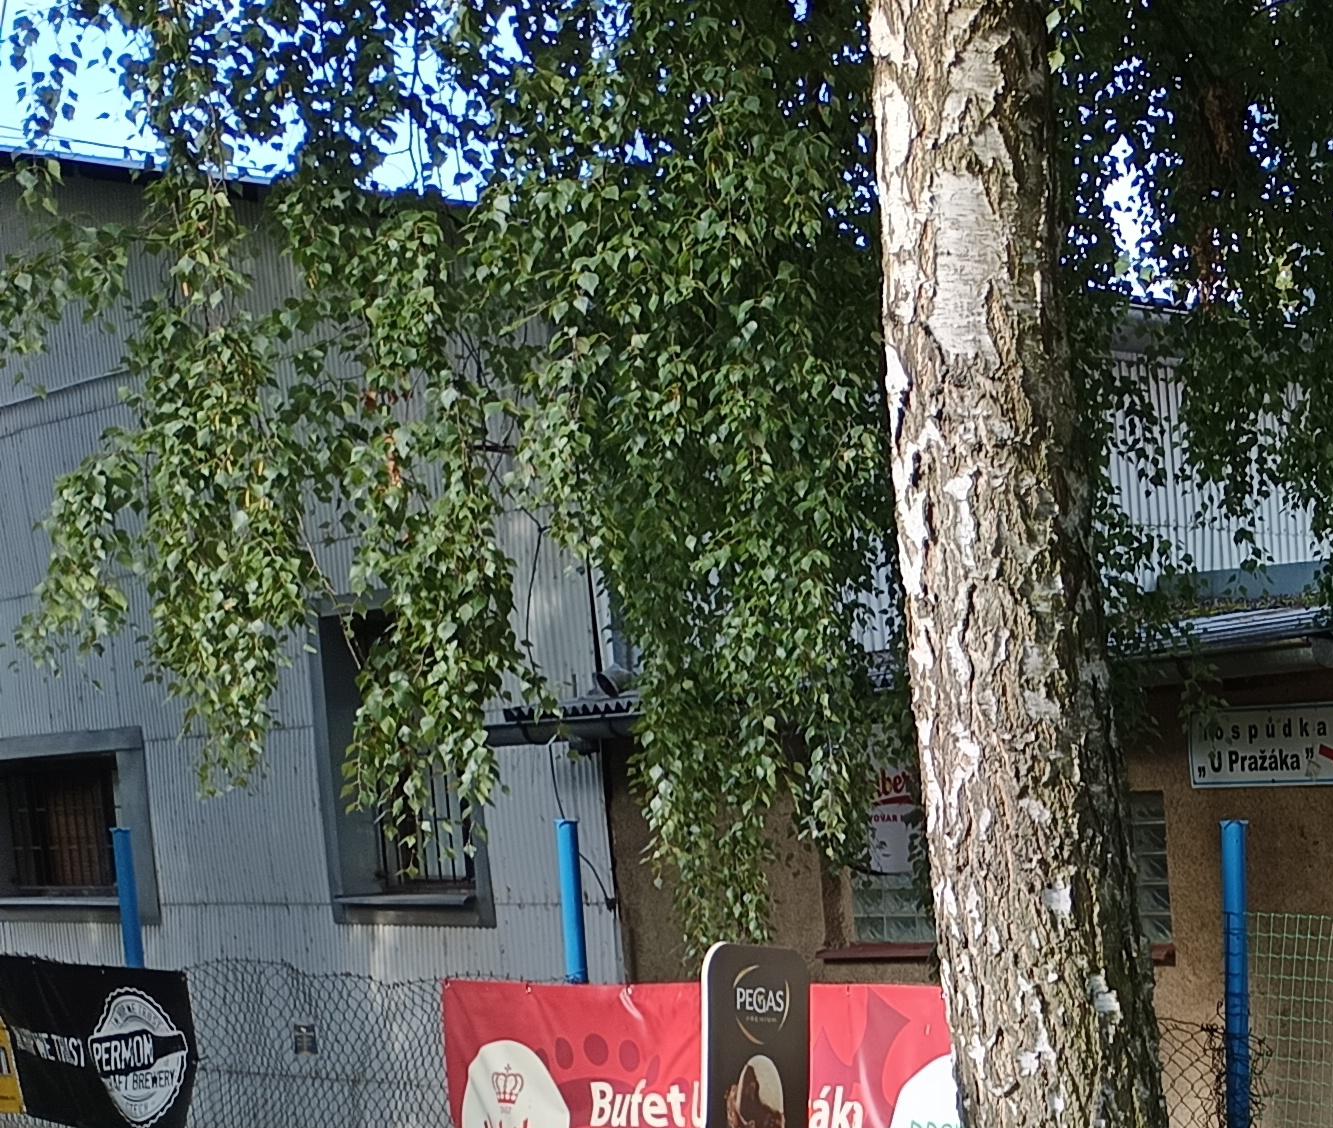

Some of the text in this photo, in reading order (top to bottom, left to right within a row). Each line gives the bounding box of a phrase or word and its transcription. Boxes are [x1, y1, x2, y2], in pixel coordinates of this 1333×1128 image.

[736, 986, 785, 1014] PEGAS
[92, 1033, 154, 1072] PERMON
[132, 1068, 176, 1091] BREWERY
[590, 1078, 687, 1128] Bufet
